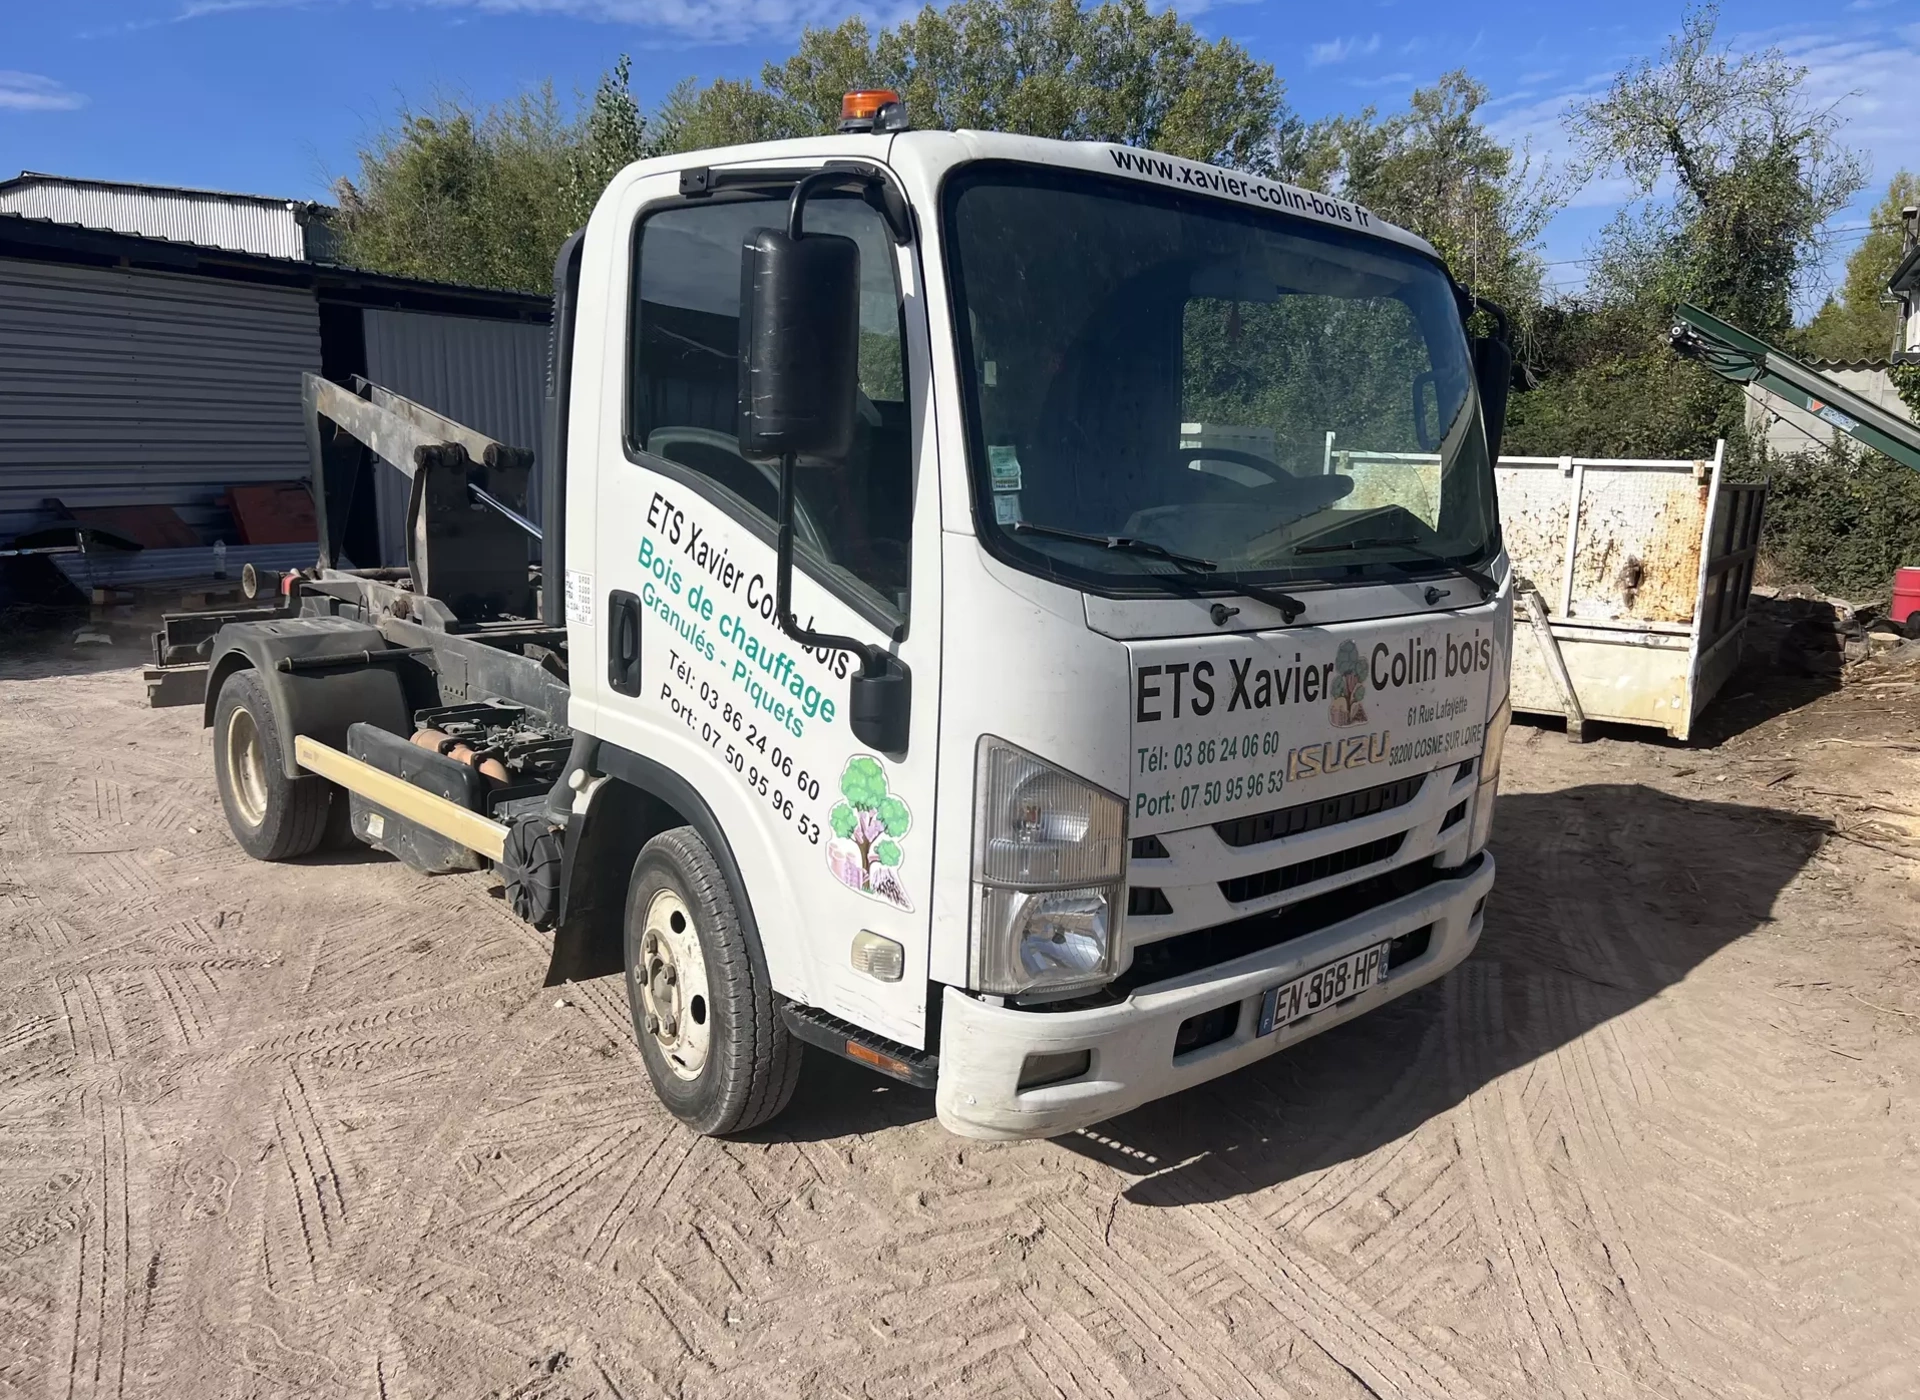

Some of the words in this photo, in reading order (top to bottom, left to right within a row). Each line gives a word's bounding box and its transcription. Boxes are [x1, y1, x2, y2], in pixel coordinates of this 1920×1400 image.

[646, 492, 684, 545] ETS
[684, 521, 744, 594] Xavier
[637, 536, 682, 595] Bois
[687, 582, 713, 621] de
[719, 614, 836, 723] chauffage
[642, 582, 715, 661] Granulés
[732, 660, 804, 738] Piquets
[1137, 661, 1215, 723] ETS
[1227, 653, 1334, 712] Xavier
[1371, 637, 1436, 691] Colin
[1445, 629, 1491, 678] bois
[1407, 706, 1417, 727] 61
[1418, 705, 1434, 724] Rue
[1435, 696, 1468, 721] Lafayette
[669, 650, 695, 690] Tél:
[699, 680, 719, 709] 03
[722, 703, 742, 732] 86
[746, 724, 766, 755] 24
[771, 747, 793, 777] 06
[797, 770, 820, 801] 60
[1137, 745, 1168, 773] Tél:
[1174, 742, 1192, 768] 03
[1197, 740, 1215, 765] 86
[1220, 736, 1238, 762] 24
[1242, 733, 1259, 758] 06
[1262, 730, 1279, 756] 60
[1286, 730, 1391, 782] ISUZU
[1389, 742, 1412, 766] 58200
[1414, 735, 1443, 759] COSNE
[1444, 729, 1460, 751] SUR
[1460, 723, 1482, 746] LOIRE
[660, 682, 698, 730] Port:
[701, 722, 722, 750] 07
[725, 746, 744, 773] 50
[748, 767, 768, 797] 95
[772, 789, 793, 820] 96
[797, 814, 820, 845] 53
[1135, 790, 1175, 818] Port:
[1181, 784, 1200, 810] 07
[1204, 780, 1221, 806] 50
[1226, 776, 1243, 802] 95
[1247, 772, 1264, 798] 96
[1267, 769, 1284, 793] 53
[1263, 1018, 1269, 1029] F
